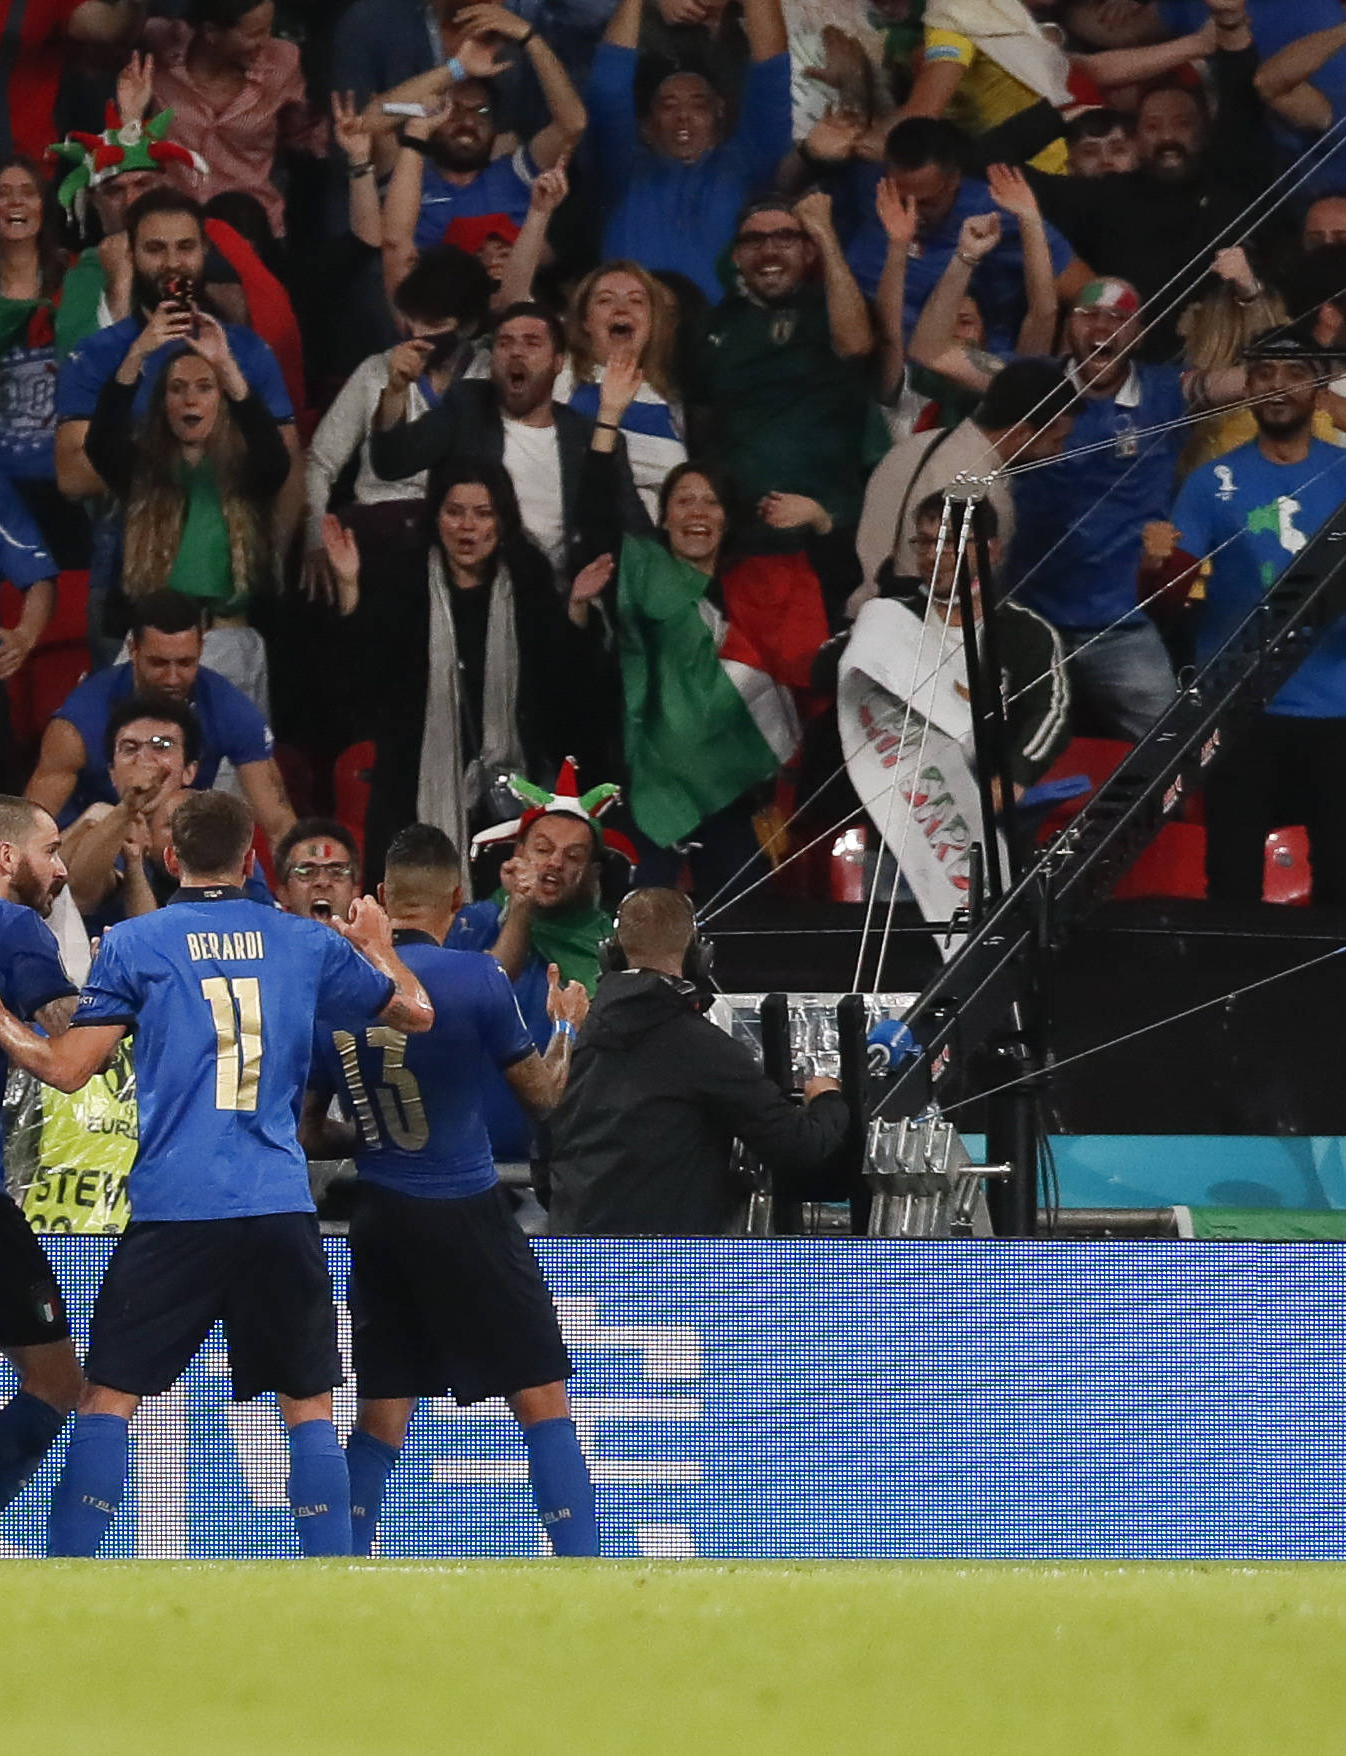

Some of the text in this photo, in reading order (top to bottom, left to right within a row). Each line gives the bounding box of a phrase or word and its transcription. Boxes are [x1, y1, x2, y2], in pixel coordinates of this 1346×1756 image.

[186, 930, 264, 962] BERARDI
[200, 976, 263, 1111] 11
[332, 1026, 430, 1152] 13
